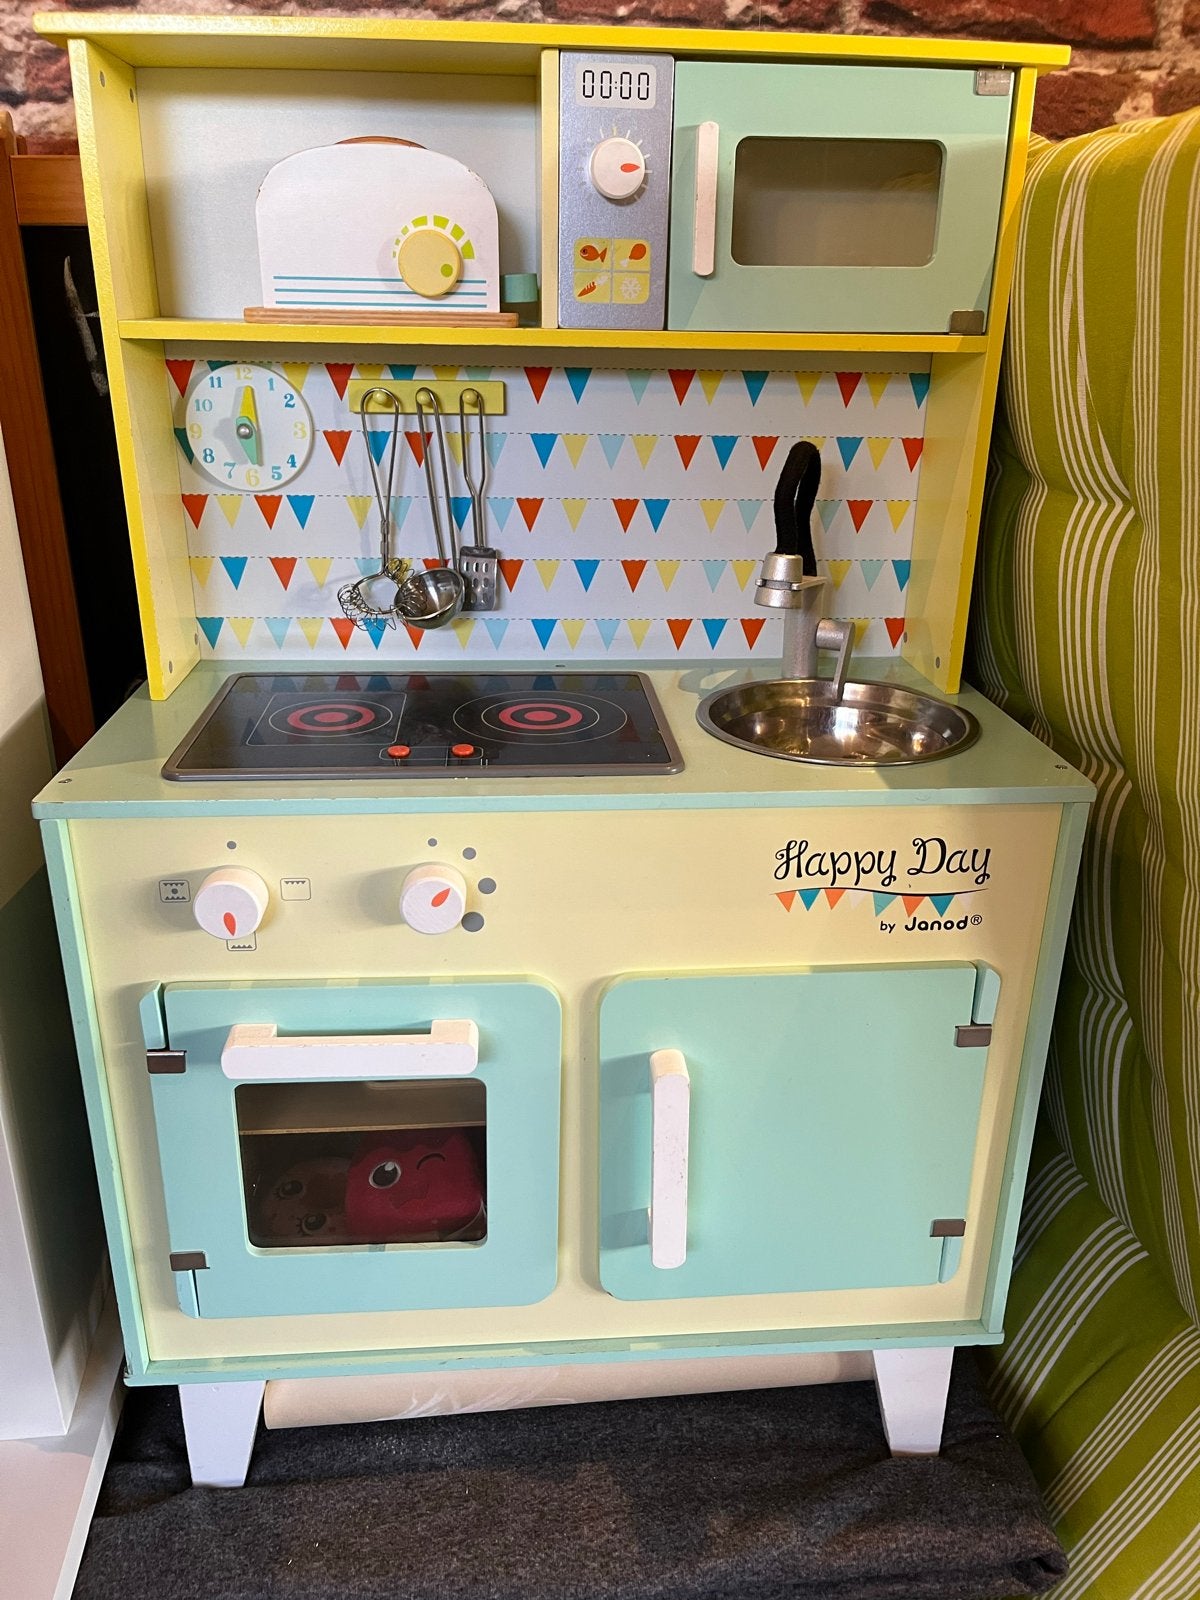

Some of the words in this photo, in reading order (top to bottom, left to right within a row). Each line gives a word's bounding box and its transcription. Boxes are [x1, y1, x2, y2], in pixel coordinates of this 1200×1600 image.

[582, 69, 650, 101] 00:00
[235, 367, 253, 380] 12
[208, 376, 223, 388] 11
[267, 377, 275, 391] 1
[194, 398, 213, 412] 10
[283, 393, 296, 408] 2
[189, 422, 203, 439] 9
[293, 421, 307, 439] 3
[202, 448, 215, 463] 8
[286, 454, 297, 468] 4
[223, 462, 236, 479] 7
[245, 468, 260, 487] 6
[271, 465, 282, 481] 5
[774, 839, 897, 887] Happy
[906, 837, 992, 885] Day
[879, 920, 896, 934] by
